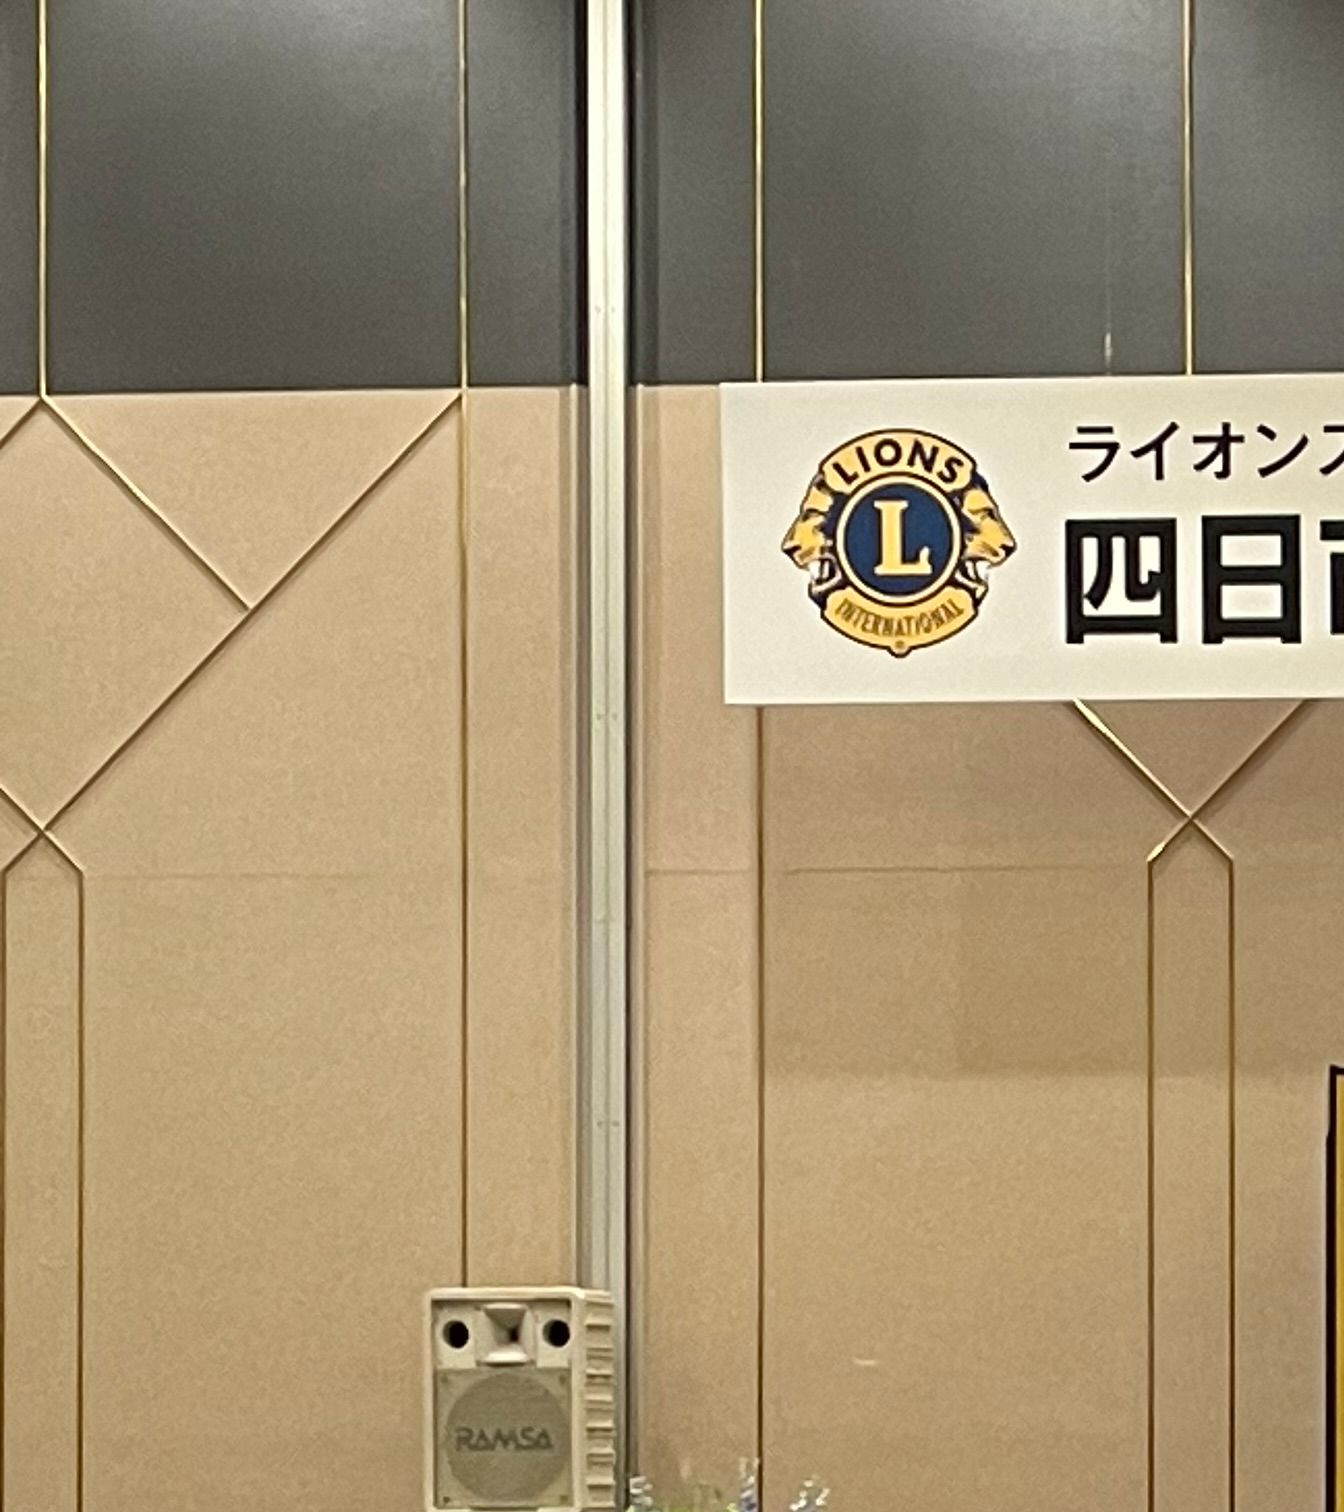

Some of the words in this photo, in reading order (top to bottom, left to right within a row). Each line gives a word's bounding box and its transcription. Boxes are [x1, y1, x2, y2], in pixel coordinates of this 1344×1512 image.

[832, 438, 965, 486] LIONS
[873, 500, 933, 576] L
[834, 597, 965, 637] INTERNATIONAL
[455, 1426, 554, 1451] RAMSA
